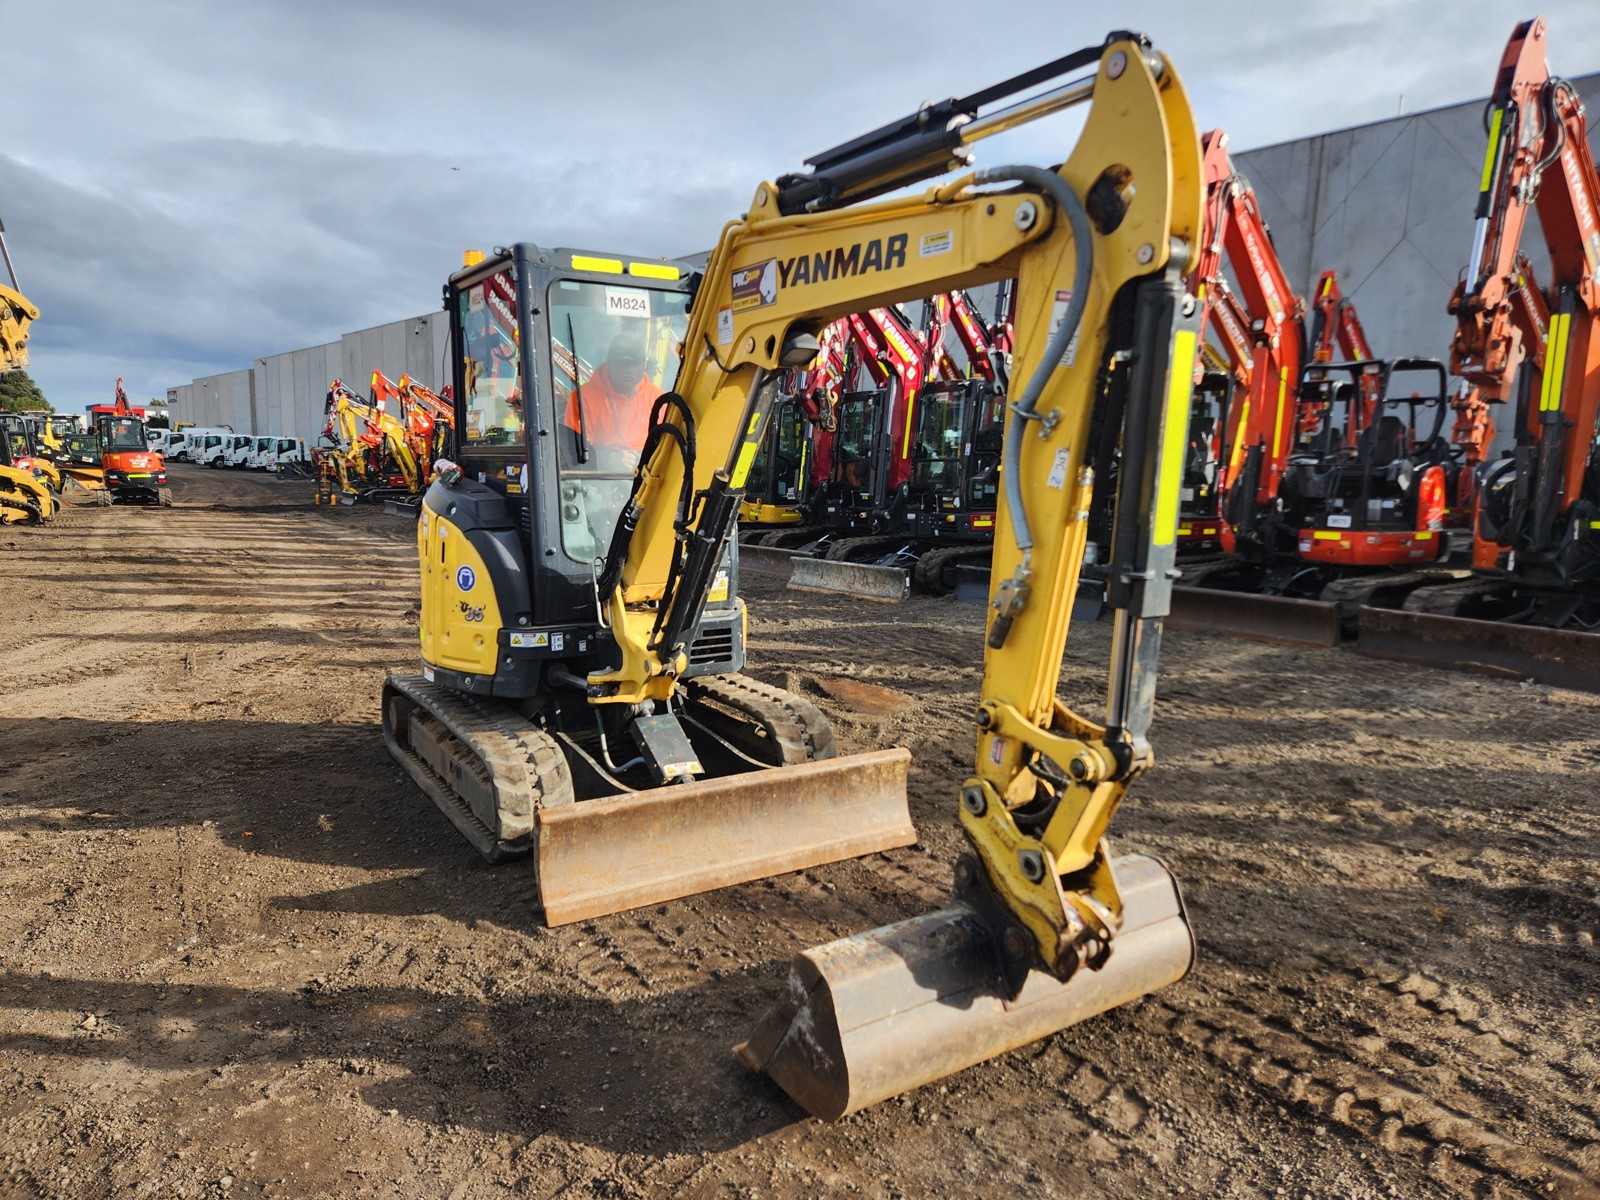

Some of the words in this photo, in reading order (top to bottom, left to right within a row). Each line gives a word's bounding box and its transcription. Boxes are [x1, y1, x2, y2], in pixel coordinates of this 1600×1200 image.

[1564, 151, 1593, 230] HITACHI
[777, 233, 908, 289] YANMAR
[610, 296, 647, 311] M824
[884, 319, 919, 366] YANMAR
